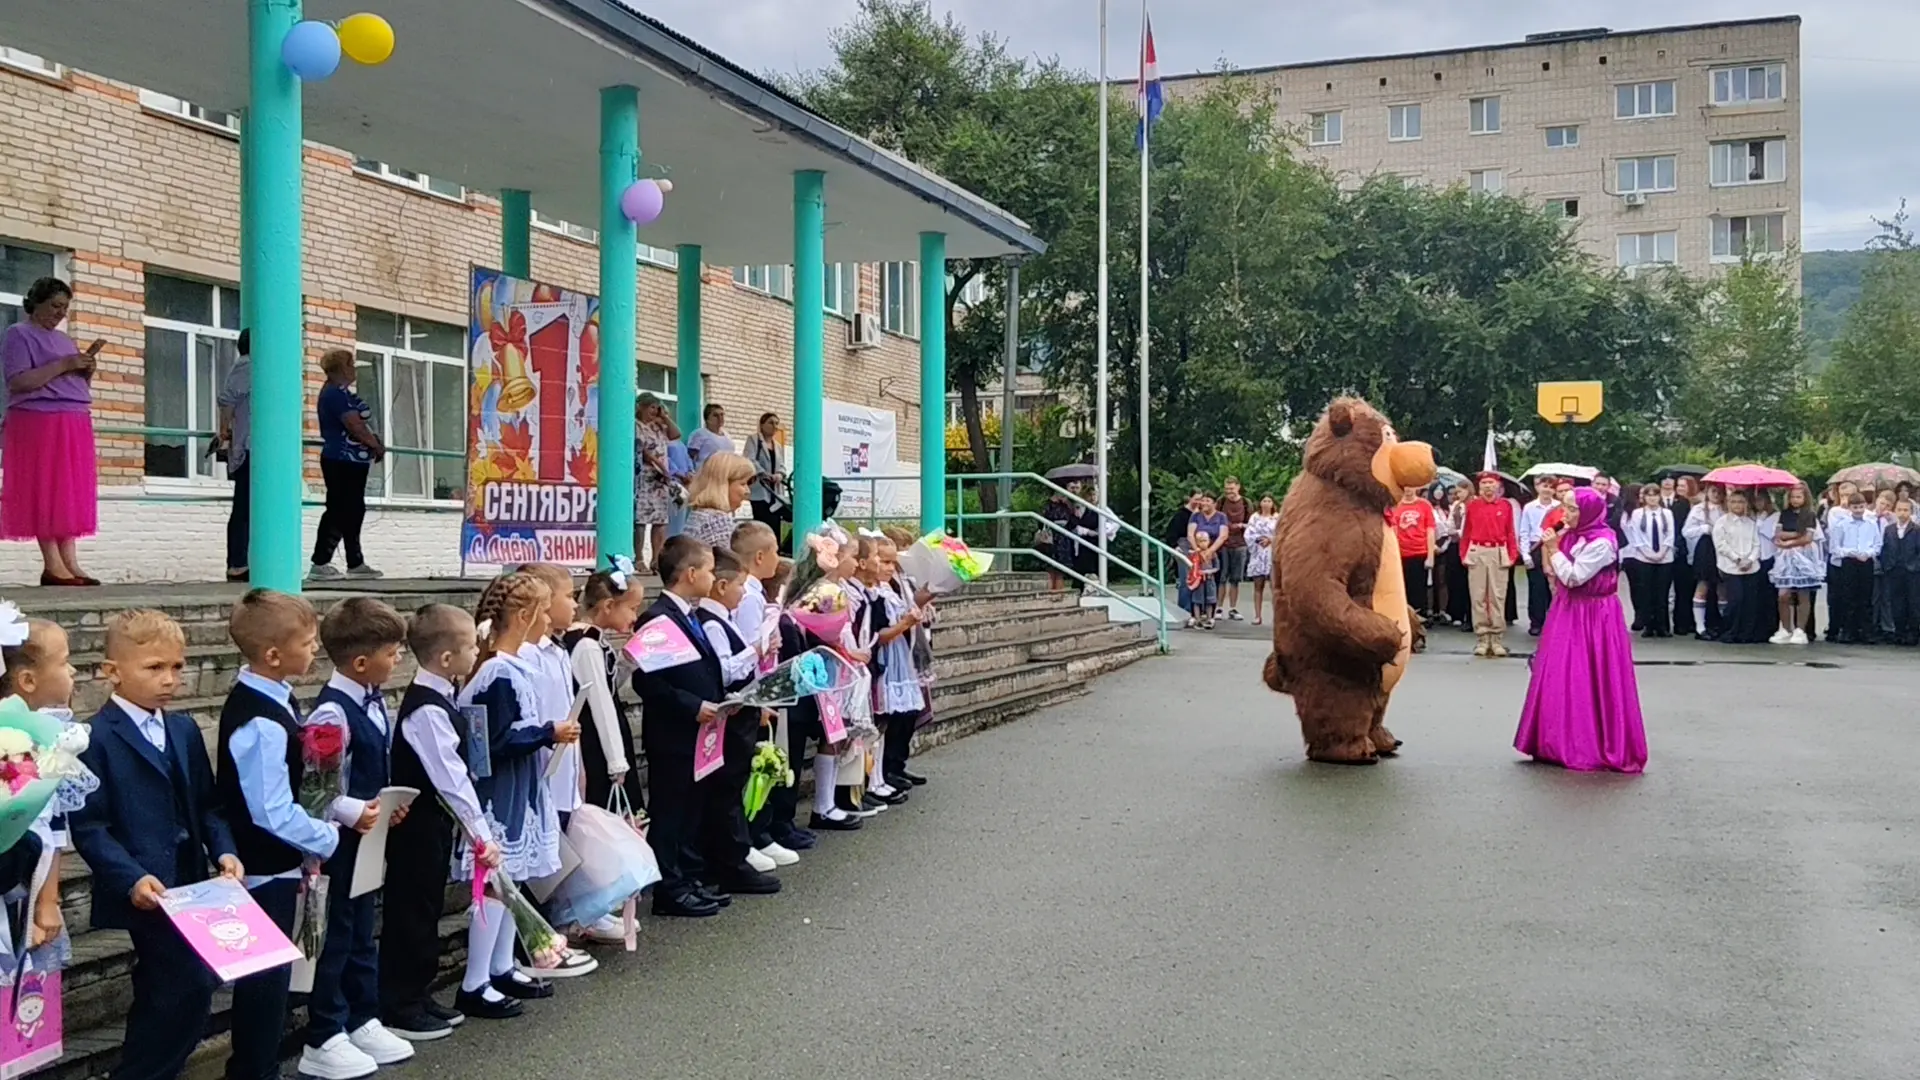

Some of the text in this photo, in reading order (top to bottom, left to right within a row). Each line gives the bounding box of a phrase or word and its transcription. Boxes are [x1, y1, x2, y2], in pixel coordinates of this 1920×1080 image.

[529, 312, 570, 480] 1
[484, 481, 597, 522] СЕНТЯБРЯ
[543, 535, 596, 561] ЗНАНИ
